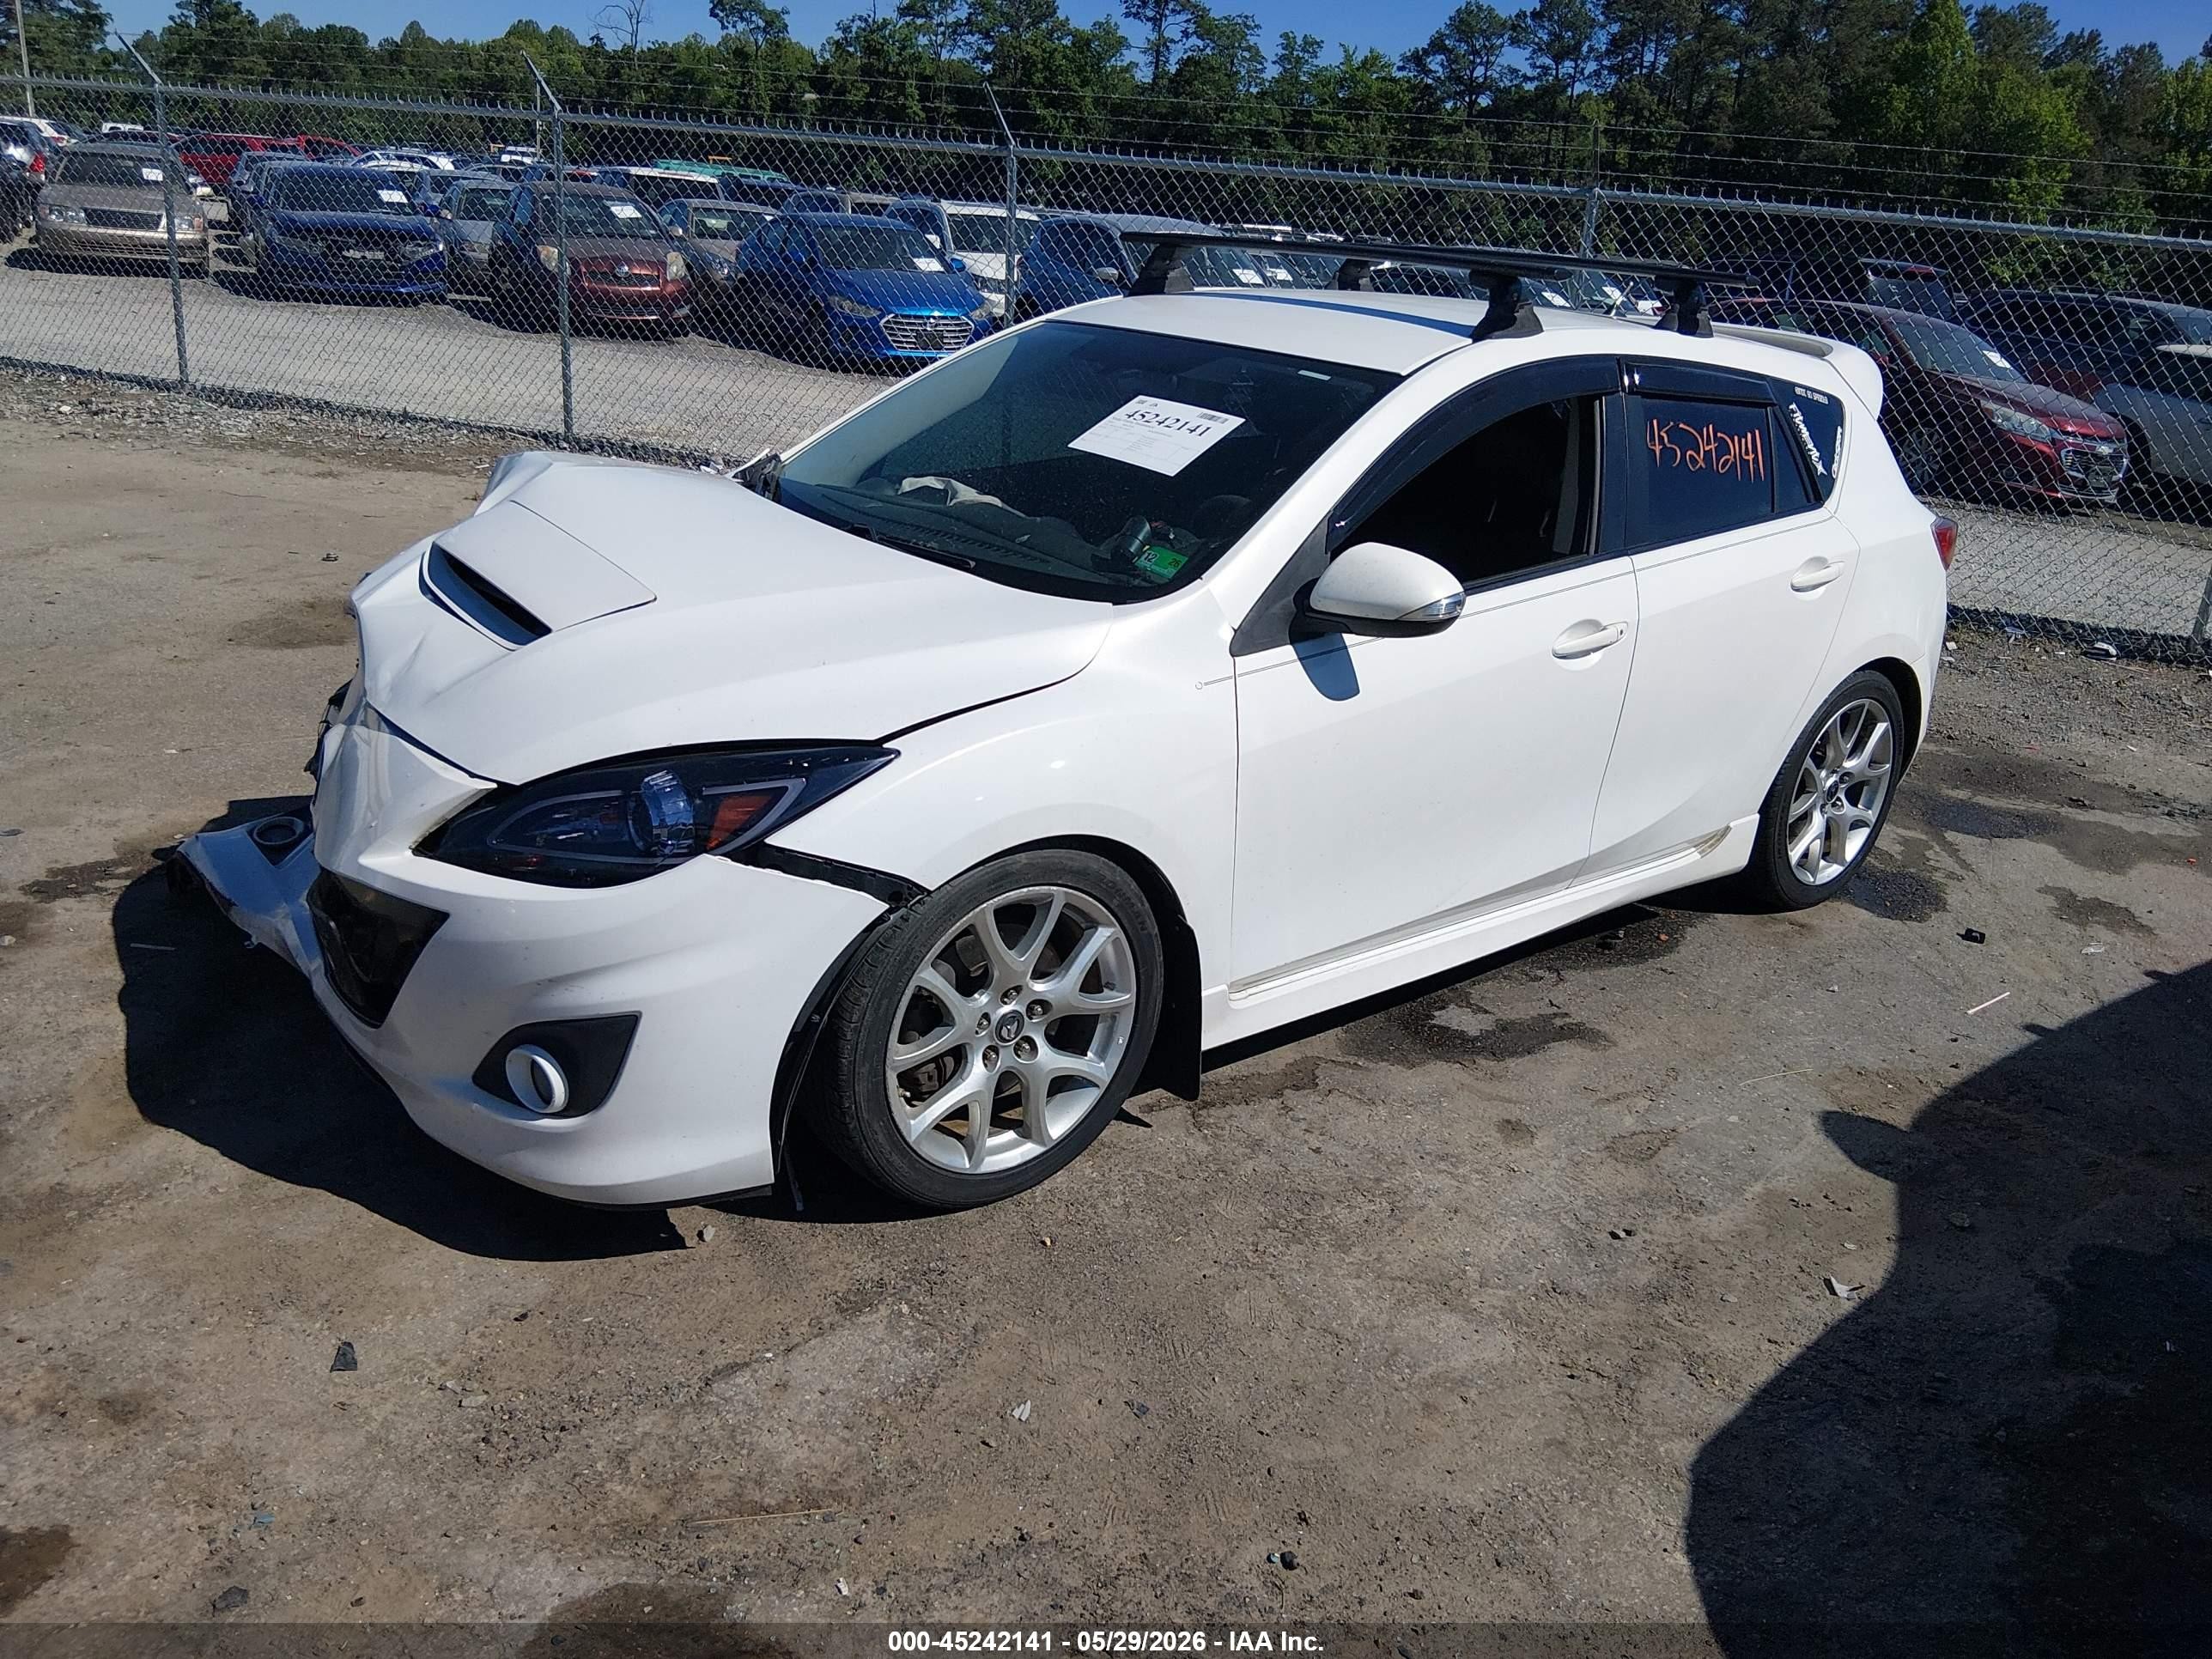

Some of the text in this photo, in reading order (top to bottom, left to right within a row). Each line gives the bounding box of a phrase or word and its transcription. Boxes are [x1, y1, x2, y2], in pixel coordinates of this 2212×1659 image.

[1125, 410, 1212, 436] 45242141
[1646, 418, 1765, 483] 45242141
[1144, 551, 1158, 563] 12
